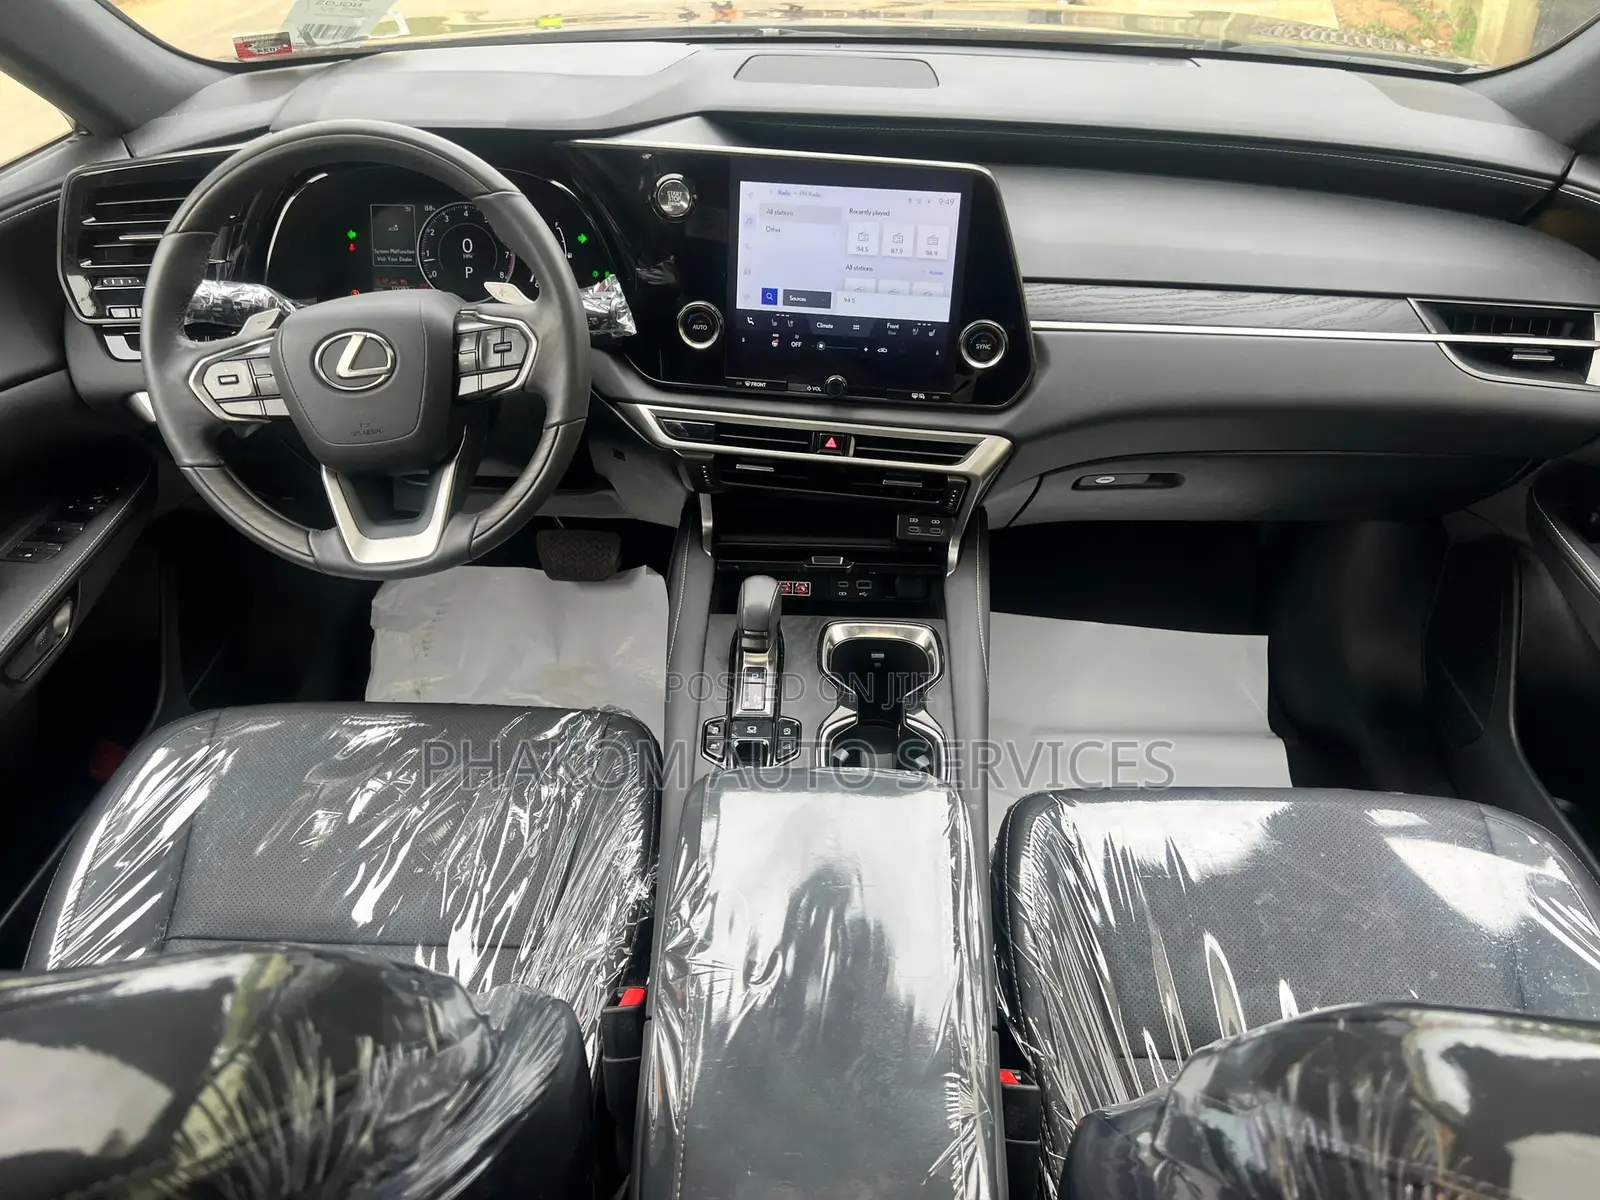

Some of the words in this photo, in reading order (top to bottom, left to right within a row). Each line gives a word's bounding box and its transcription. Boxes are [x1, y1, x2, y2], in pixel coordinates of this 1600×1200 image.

[938, 197, 955, 206] 9:49
[849, 207, 872, 217] Recently
[872, 209, 891, 217] played
[856, 245, 869, 253] 94.5
[853, 264, 874, 272] stations
[465, 266, 474, 279] P
[499, 271, 505, 279] 8
[789, 294, 807, 302] Sources
[816, 321, 834, 329] Climate
